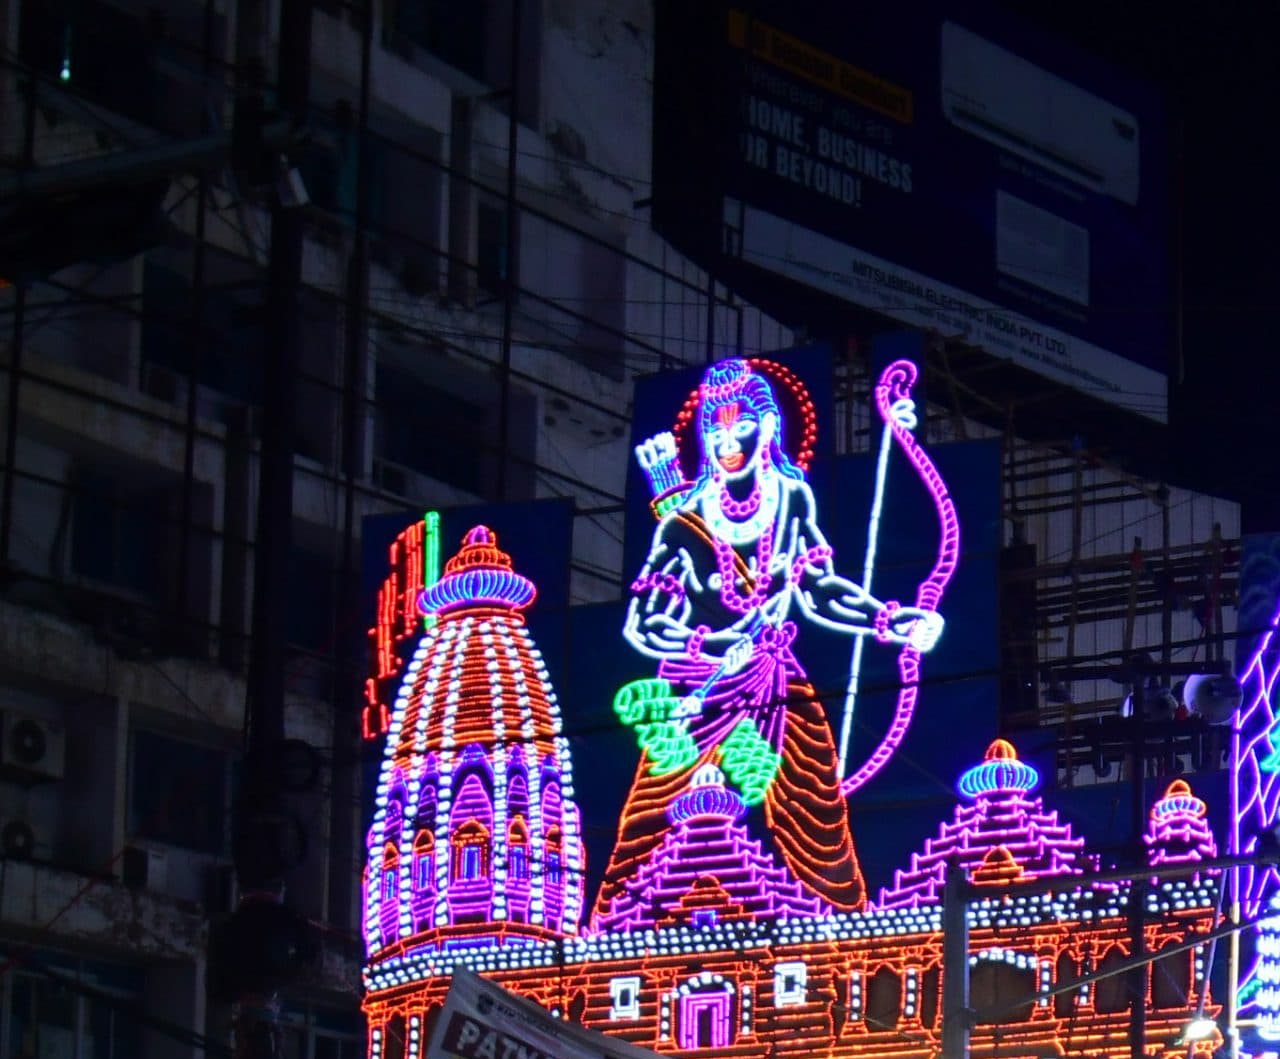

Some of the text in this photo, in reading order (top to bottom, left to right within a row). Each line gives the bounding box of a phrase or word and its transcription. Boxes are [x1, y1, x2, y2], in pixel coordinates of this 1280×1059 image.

[776, 144, 863, 208] BEYOND!
[817, 125, 912, 192] BUSINESS
[985, 310, 1017, 337] INDIA
